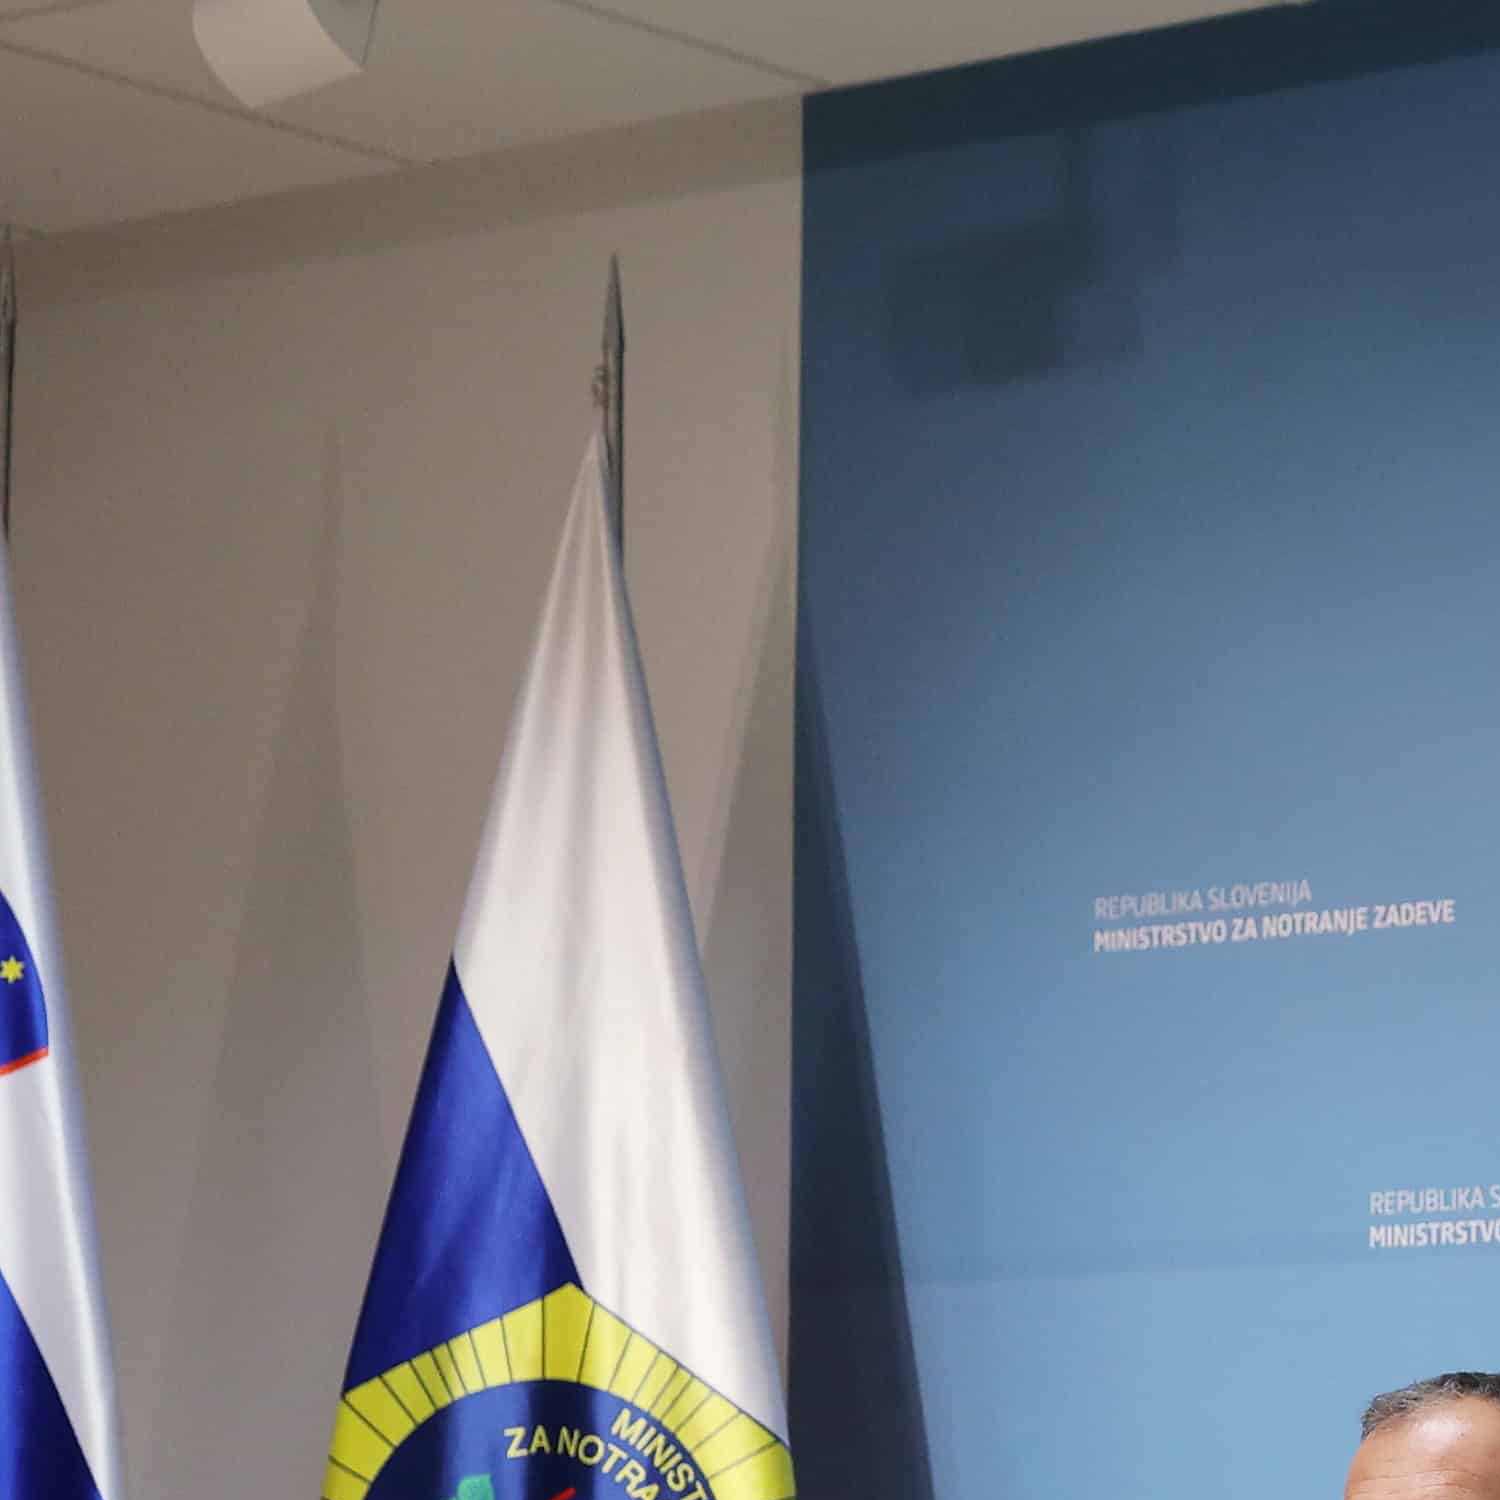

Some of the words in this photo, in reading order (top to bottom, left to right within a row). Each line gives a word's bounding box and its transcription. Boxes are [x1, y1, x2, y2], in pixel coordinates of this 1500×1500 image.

[1094, 889, 1204, 920] REPUBLIKA
[1207, 879, 1312, 911] SLOVENIJA
[1094, 919, 1227, 952] MINISTRSTVO
[1231, 916, 1258, 942] ZA
[1262, 906, 1368, 938] NOTRANJE
[1373, 899, 1455, 929] ZADEVE
[1370, 1186, 1486, 1215] REPUBLIKA
[503, 1425, 551, 1460] ZA
